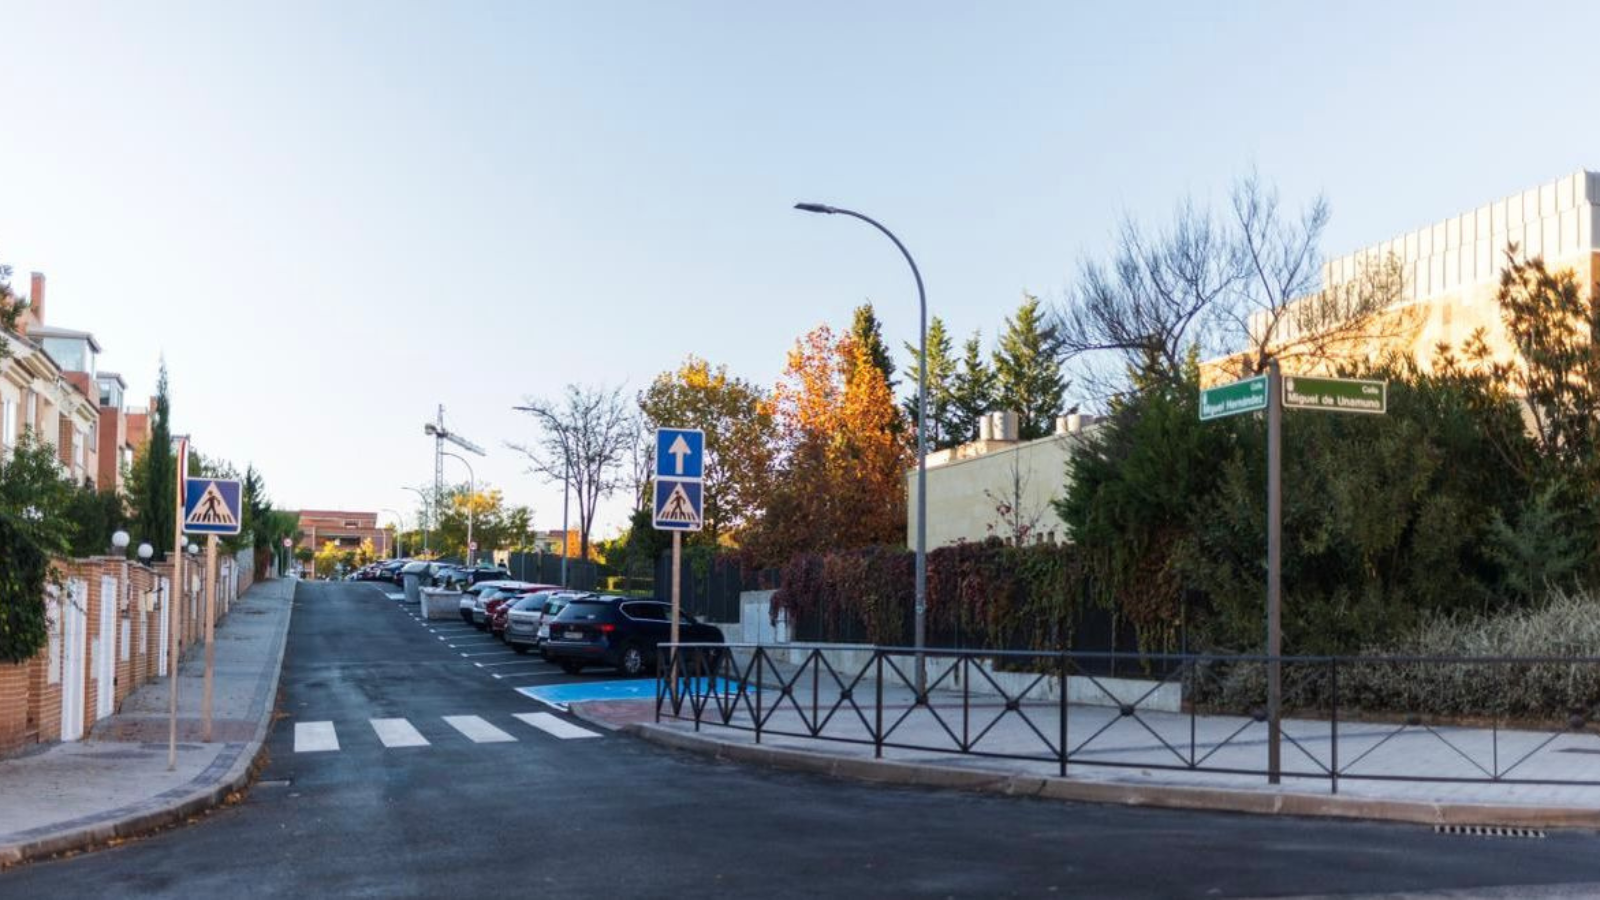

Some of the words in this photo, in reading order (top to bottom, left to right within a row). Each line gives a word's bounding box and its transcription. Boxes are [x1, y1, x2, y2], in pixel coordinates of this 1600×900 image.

[1361, 385, 1379, 394] Calle
[1287, 392, 1318, 405] Miguel
[1321, 395, 1334, 405] de
[1337, 396, 1380, 408] Unamuno
[1203, 401, 1225, 416] Miguel
